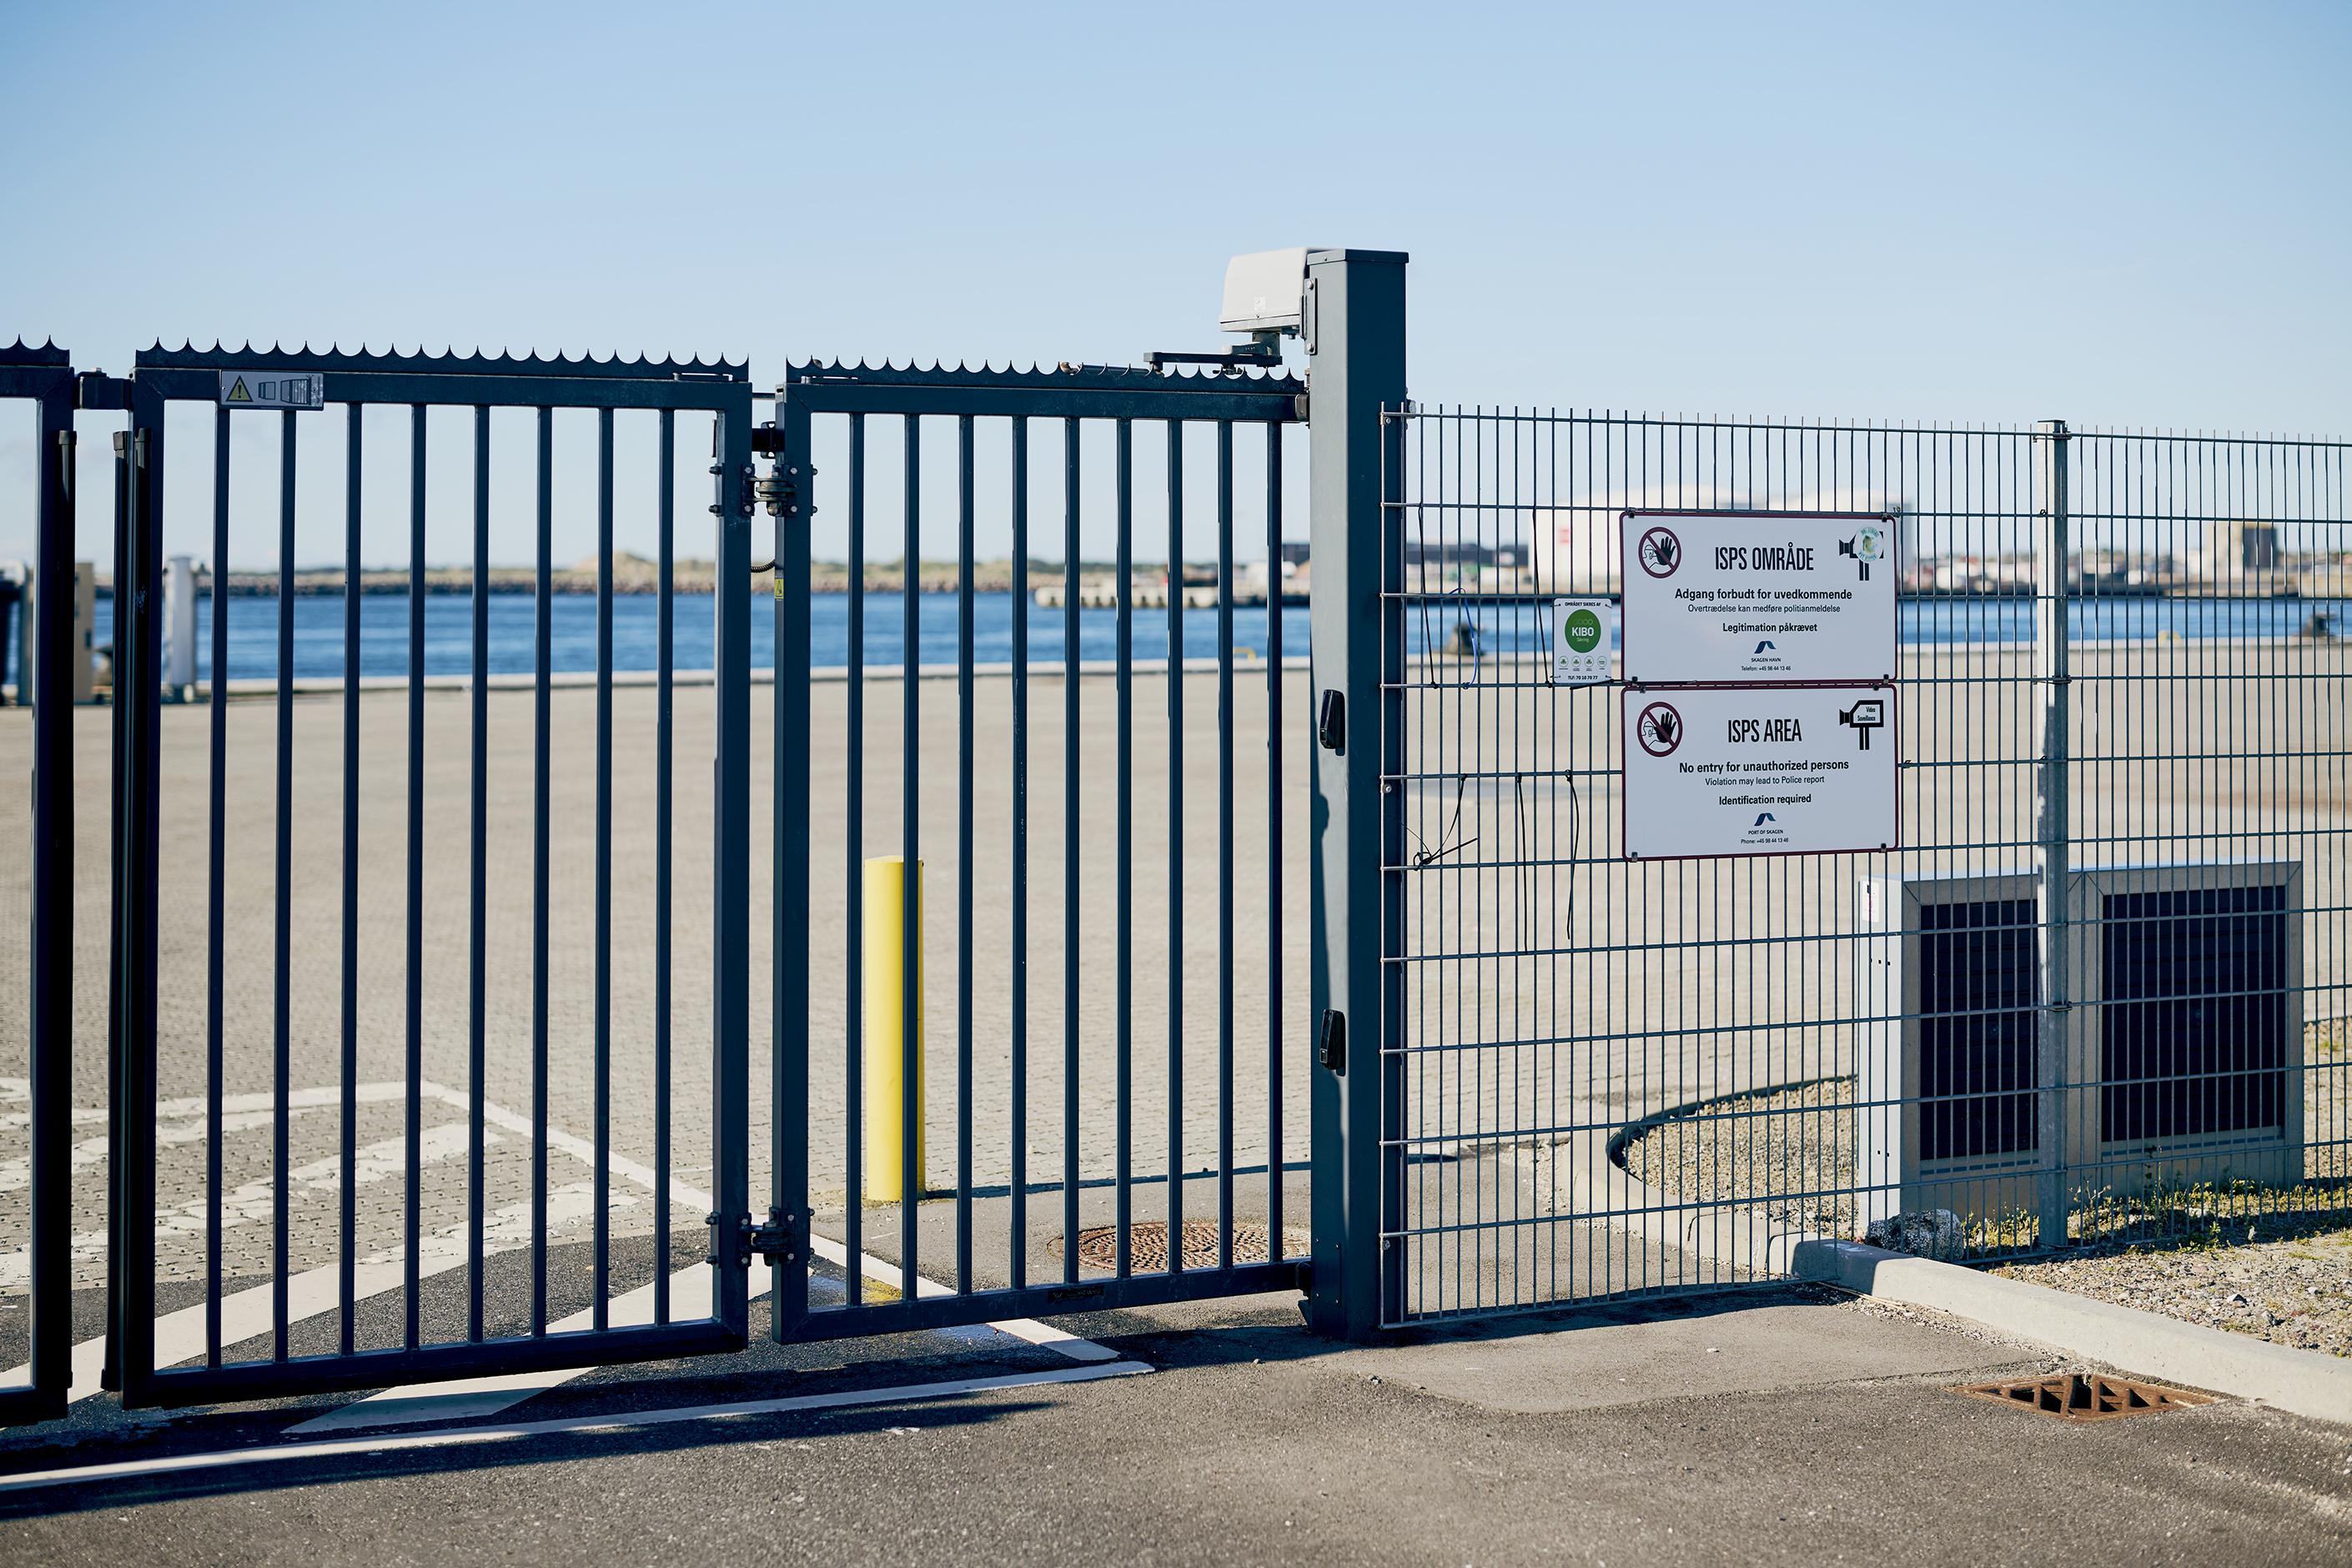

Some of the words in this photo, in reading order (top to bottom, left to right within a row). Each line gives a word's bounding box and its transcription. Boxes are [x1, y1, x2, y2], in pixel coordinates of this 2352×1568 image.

[1715, 546, 1747, 570] ISPS
[1752, 541, 1814, 570] OMRÅDE
[1675, 588, 1715, 601] Adgang
[1716, 588, 1755, 600] forbudt
[1757, 588, 1772, 600] for
[1774, 589, 1852, 600] uvedkommende
[1687, 604, 1736, 614] Overtrædelse
[1738, 605, 1751, 613] kan
[1752, 605, 1782, 613] medføre
[1784, 605, 1841, 615] politianmeldelse
[1571, 626, 1595, 636] KIBO
[1722, 622, 1777, 634] Legitimation
[1779, 622, 1818, 634] påkrævet
[1728, 719, 1760, 743] ISPS
[1763, 718, 1802, 742] AREA
[1679, 762, 1695, 774] No
[1696, 763, 1724, 776] entry
[1726, 761, 1741, 773] for
[1742, 760, 1808, 772] unauthorized
[1811, 761, 1849, 774] persons
[1705, 776, 1737, 787] Violation
[1756, 776, 1771, 785] lead
[1772, 776, 1780, 785] to
[1782, 776, 1802, 784] Police
[1803, 776, 1825, 787] report
[1719, 795, 1774, 806] Identification
[1777, 794, 1812, 807] required
